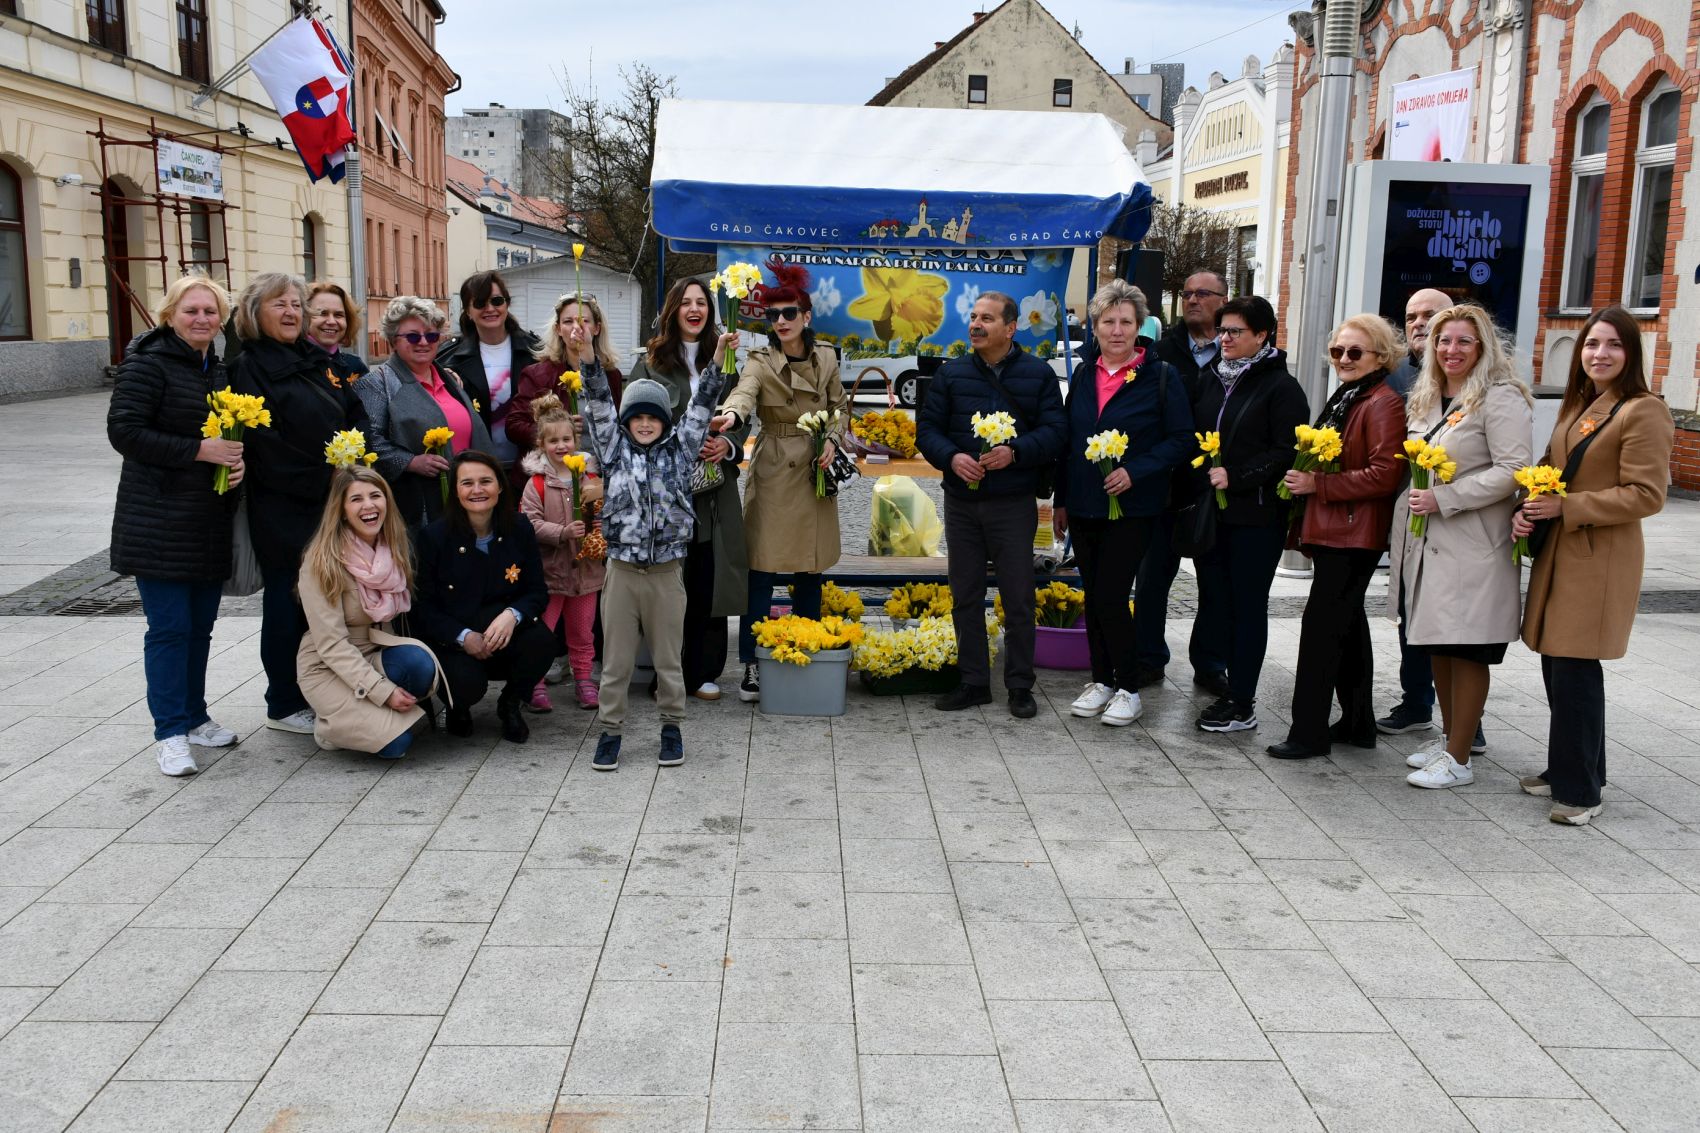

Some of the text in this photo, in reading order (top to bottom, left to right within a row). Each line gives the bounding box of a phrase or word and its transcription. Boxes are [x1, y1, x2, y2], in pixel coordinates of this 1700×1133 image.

[1396, 88, 1469, 114] DAN ZDRAVOG OSMIJEHA
[181, 149, 205, 165] ČAKOVEC
[1406, 207, 1444, 219] DOŽIVJETI
[710, 223, 839, 237] GRAD ČAKOVEC
[1418, 219, 1443, 229] STOTU
[1442, 209, 1502, 245] bijelo
[1009, 232, 1051, 241] GRAD
[1427, 230, 1502, 272] dugme
[770, 253, 832, 265] CVJETOM
[834, 256, 892, 269] NARCISA
[894, 259, 945, 271] PROTIV
[945, 261, 981, 272] RAKA
[984, 264, 1026, 275] DOJKE
